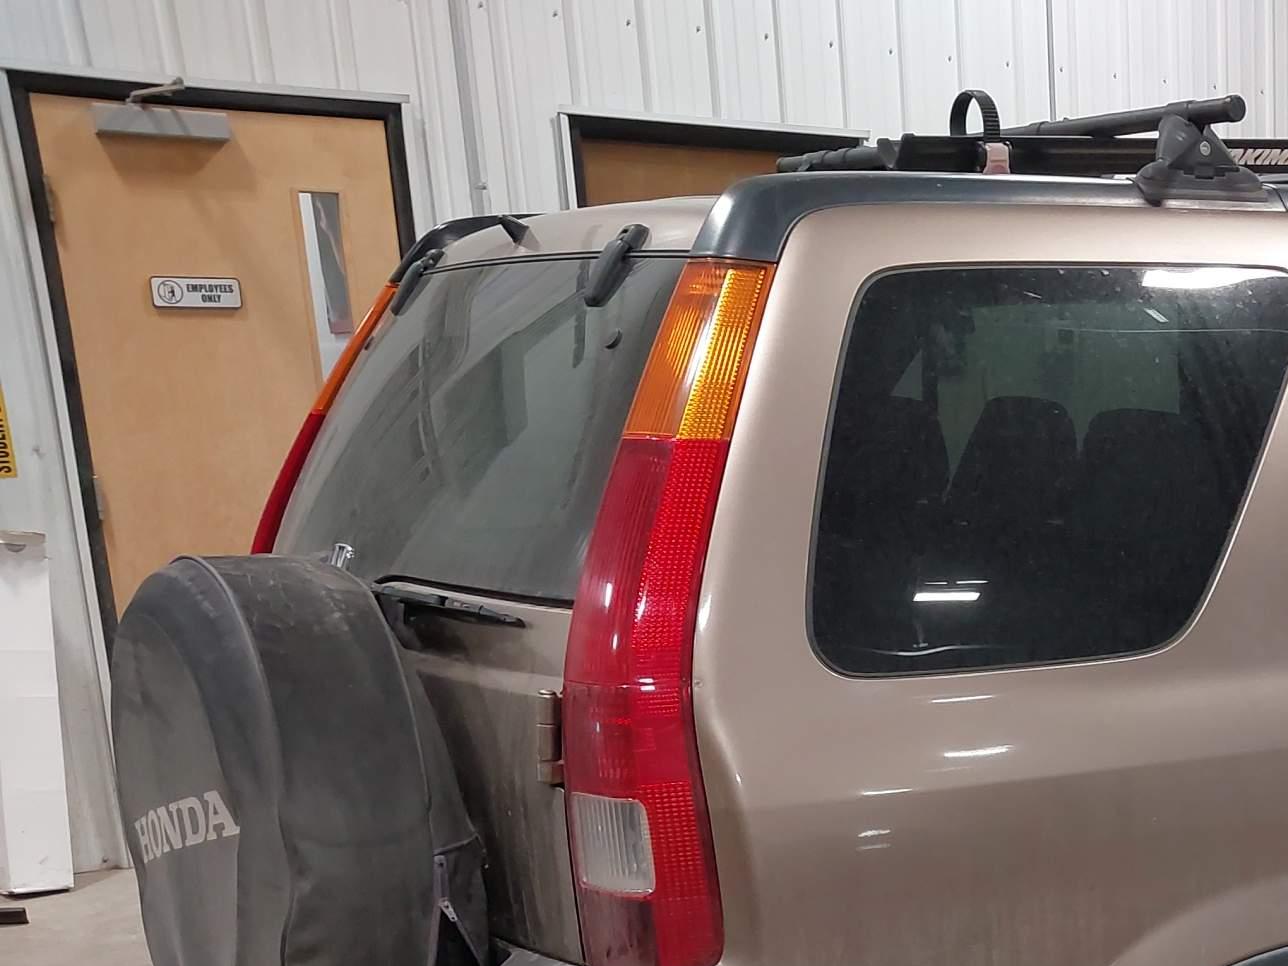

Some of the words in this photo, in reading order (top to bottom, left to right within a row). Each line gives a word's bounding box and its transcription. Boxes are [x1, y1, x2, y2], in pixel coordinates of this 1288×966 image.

[186, 284, 233, 293] EMPLOYEES
[201, 294, 221, 303] ONLY
[134, 790, 240, 864] HONDA
